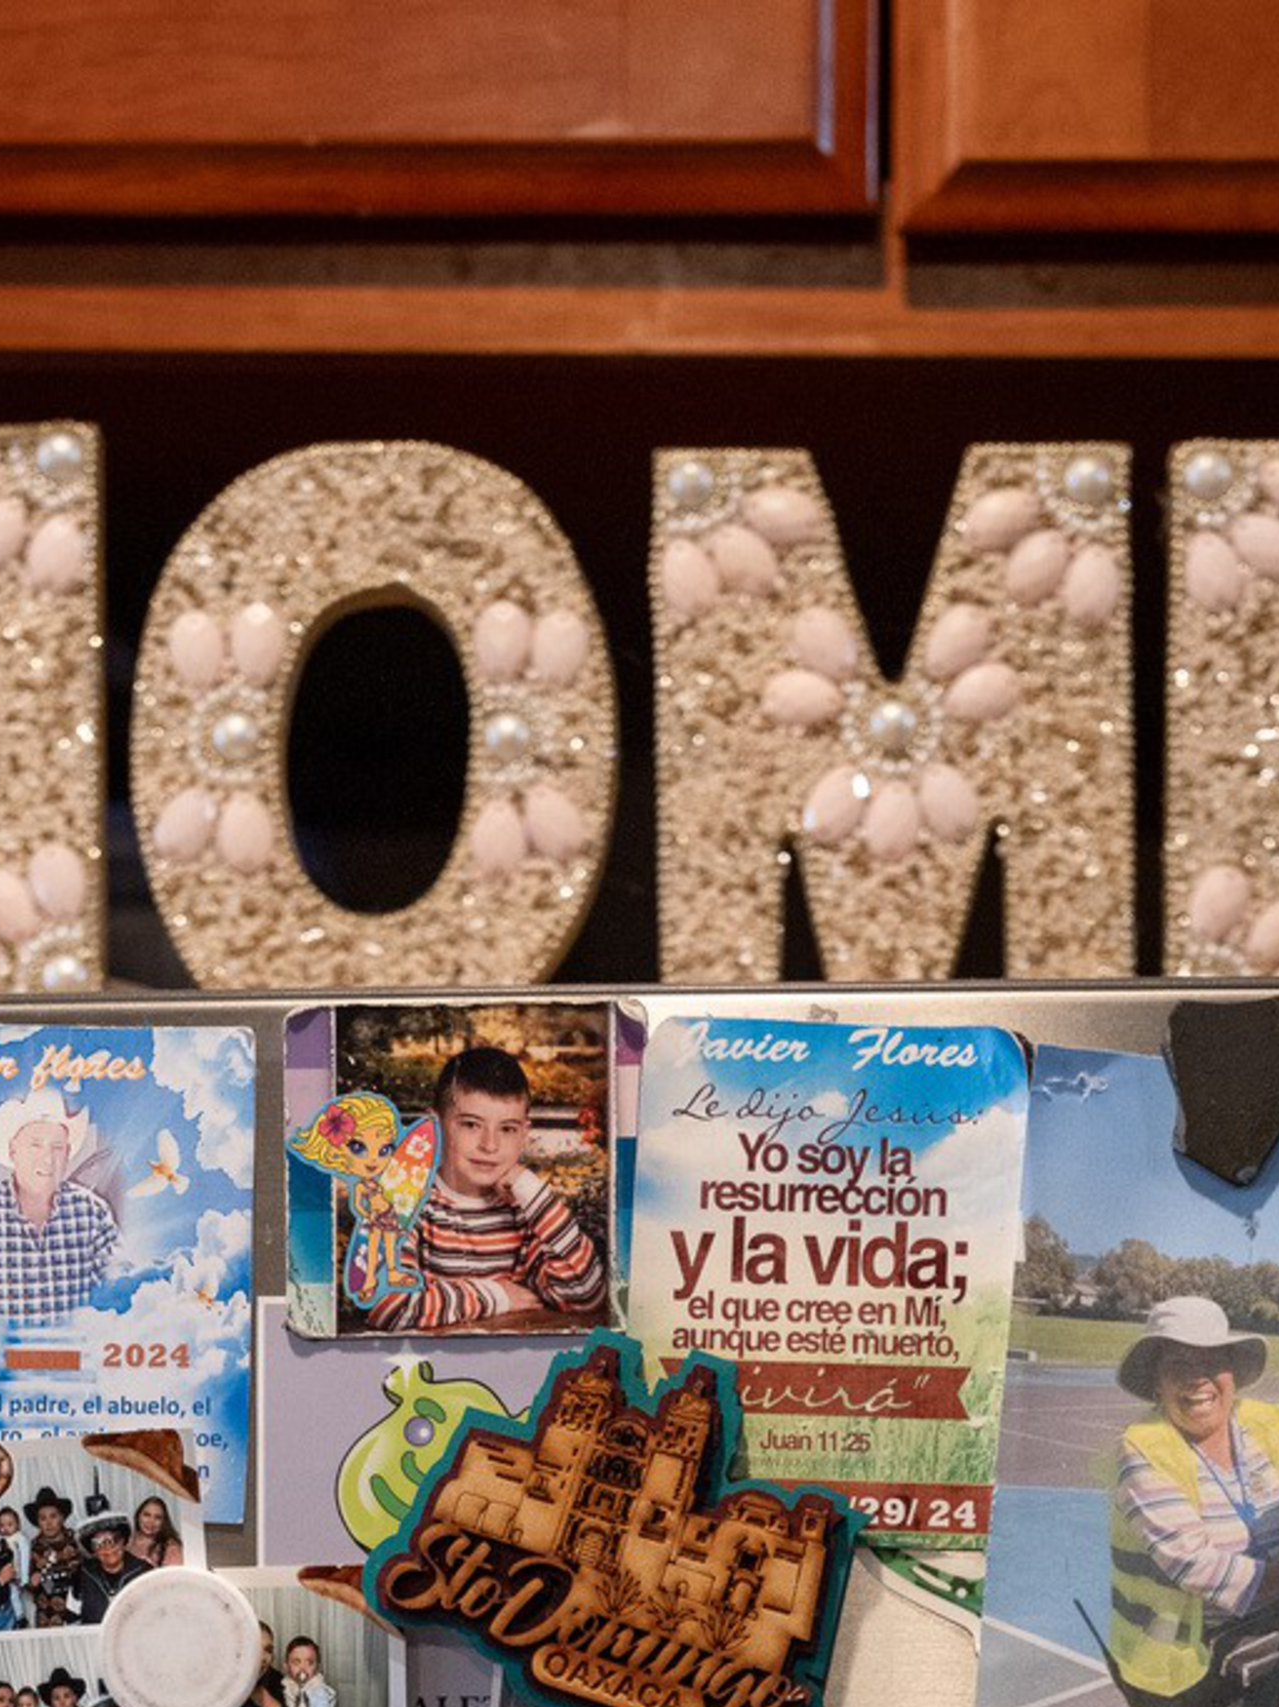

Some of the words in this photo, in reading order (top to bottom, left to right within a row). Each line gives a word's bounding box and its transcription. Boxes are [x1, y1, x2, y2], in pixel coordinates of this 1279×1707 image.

[31, 1043, 147, 1091] flores
[673, 1022, 810, 1066] Javier
[847, 1028, 978, 1070] Flores
[102, 1343, 190, 1369] 2024
[386, 1522, 502, 1619] Sto
